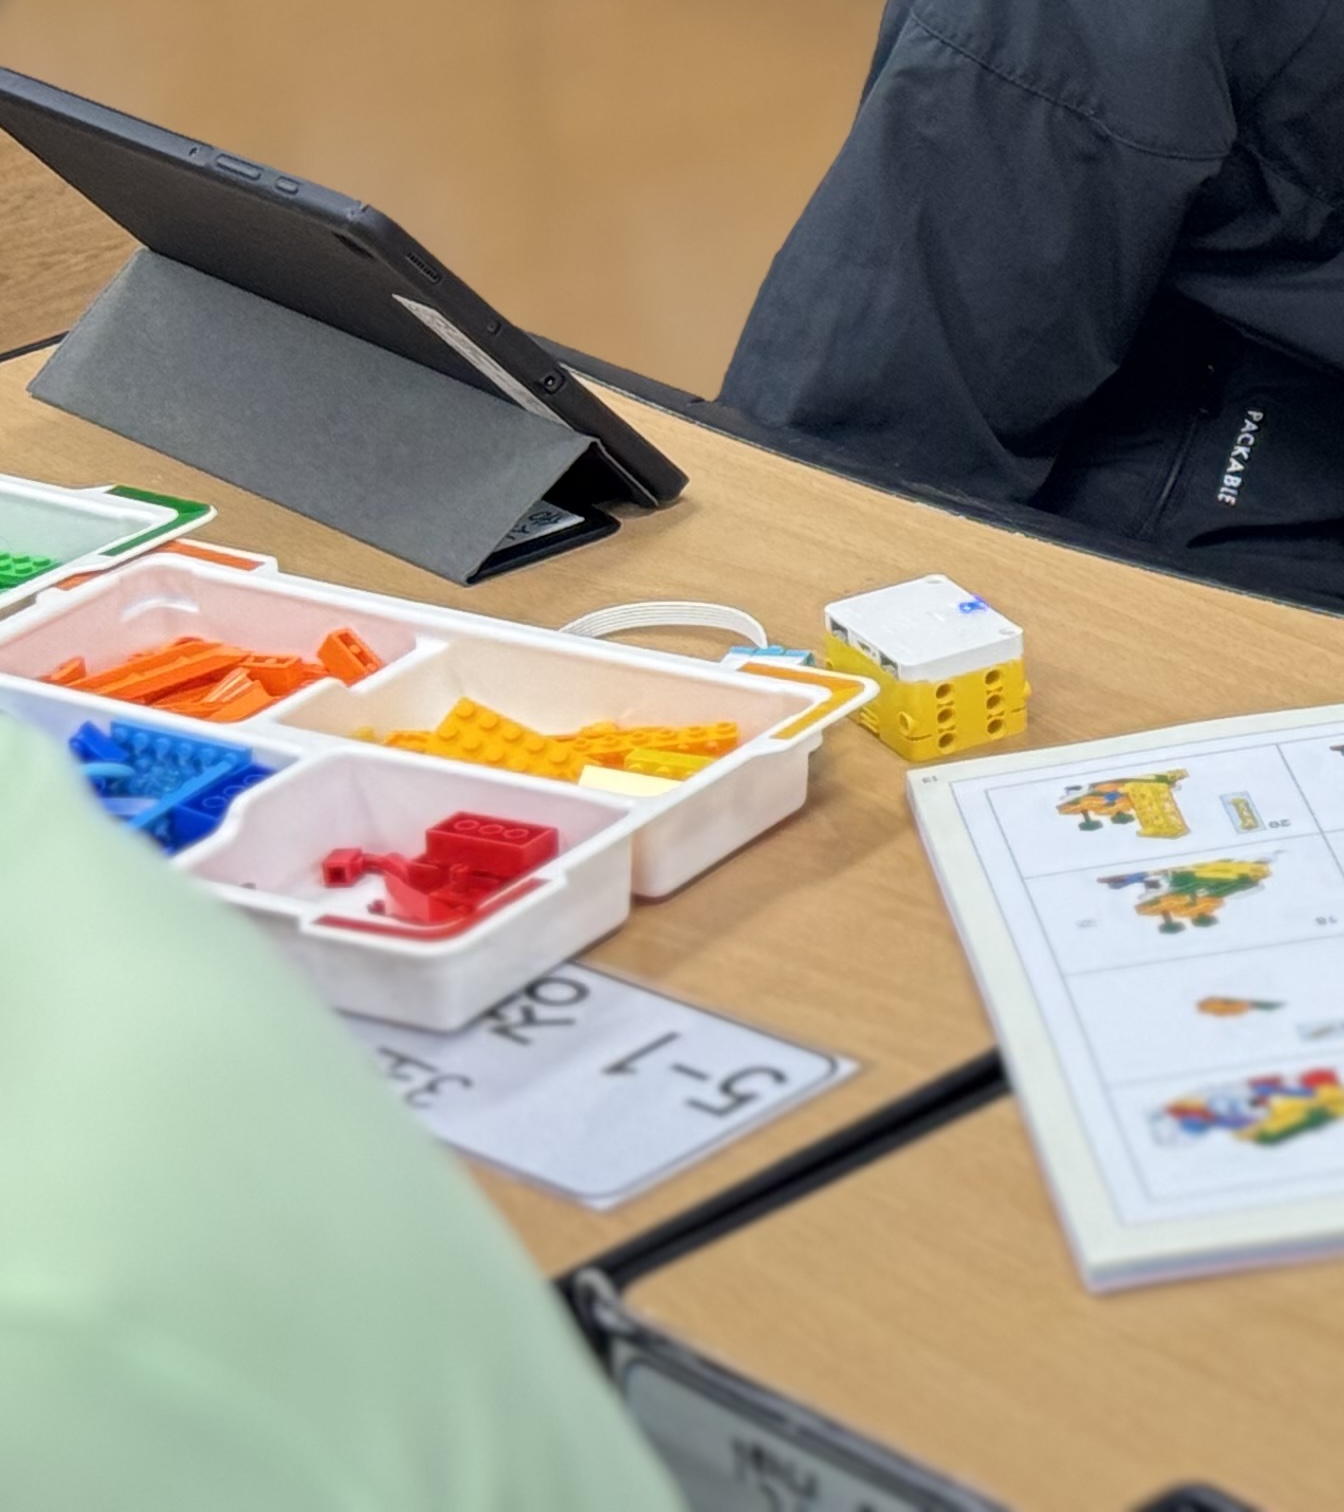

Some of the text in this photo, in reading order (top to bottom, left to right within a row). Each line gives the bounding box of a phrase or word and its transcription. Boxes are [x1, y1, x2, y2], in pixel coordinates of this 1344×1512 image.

[1216, 408, 1264, 507] PACKABLE
[1267, 818, 1292, 830] 20
[601, 1029, 791, 1118] 5-1
